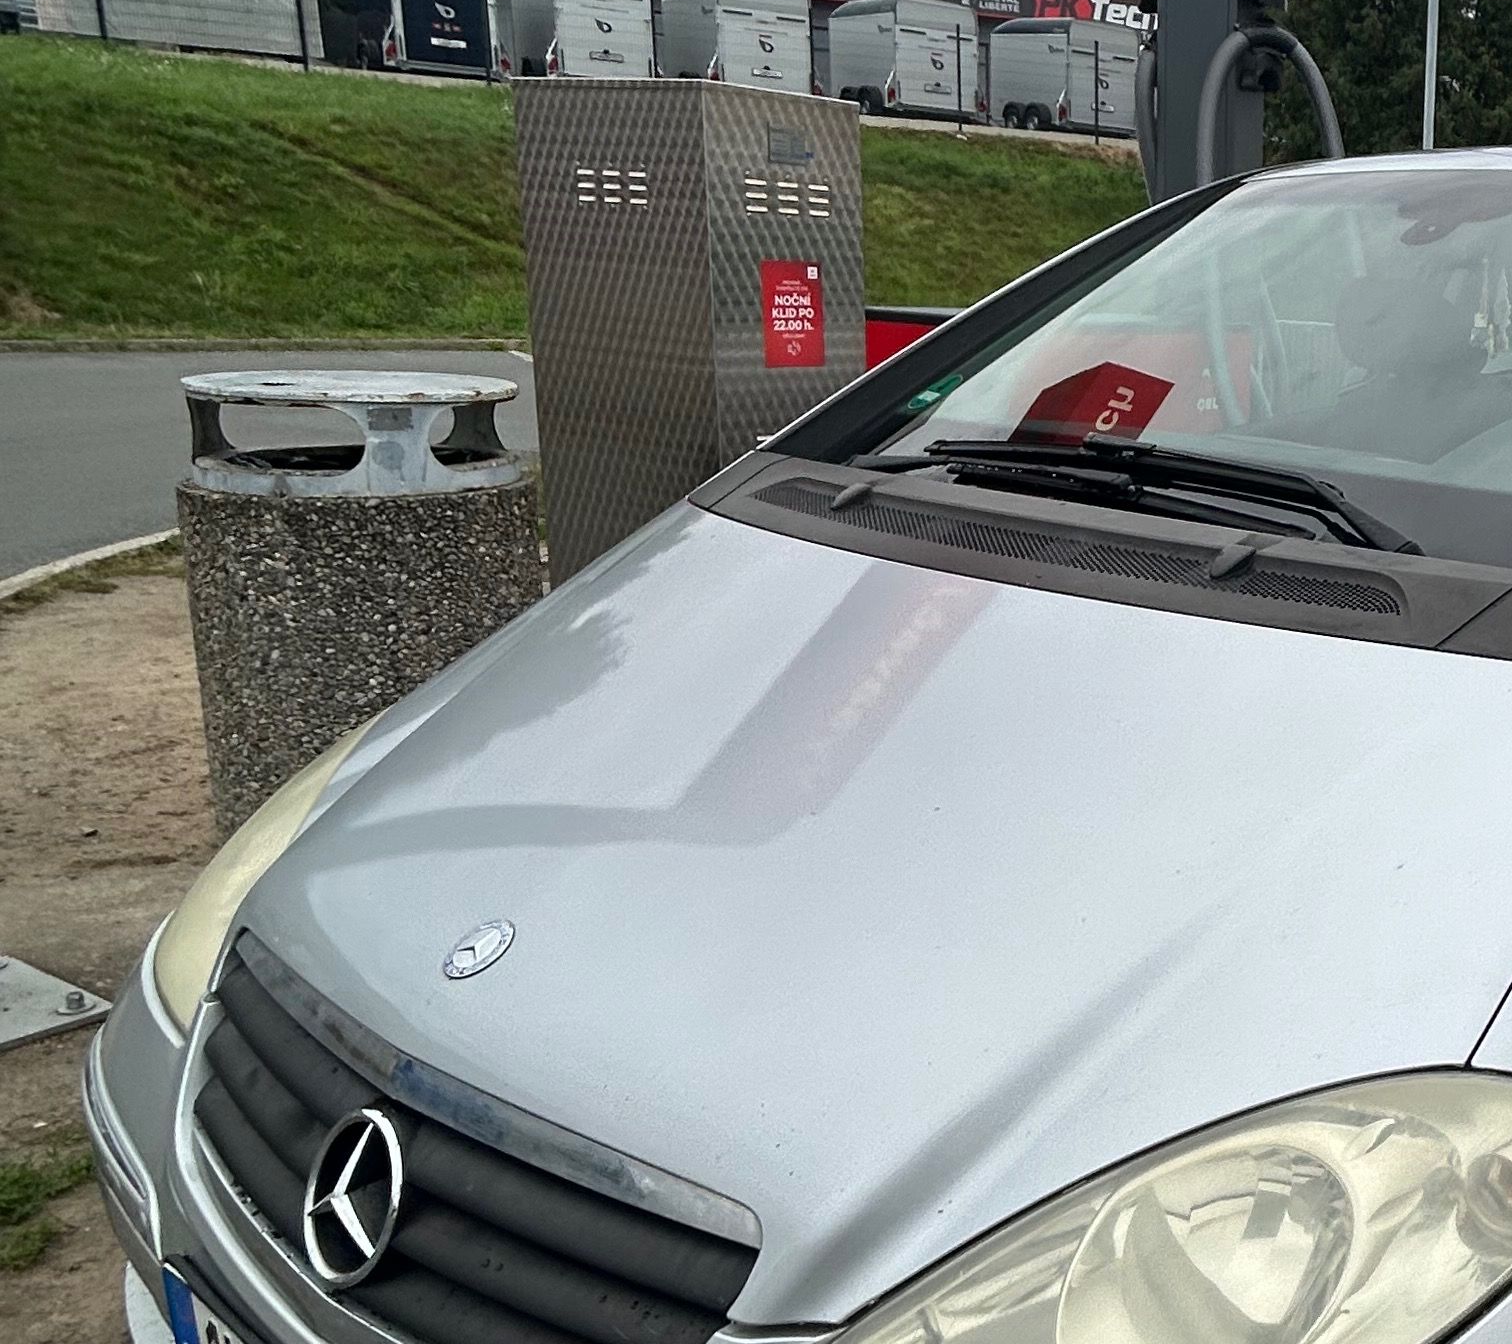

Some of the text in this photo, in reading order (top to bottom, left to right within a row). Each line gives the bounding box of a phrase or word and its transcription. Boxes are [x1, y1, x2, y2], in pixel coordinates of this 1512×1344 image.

[774, 293, 811, 306] NOČNÍ
[772, 307, 814, 319] KLID PO
[773, 319, 803, 331] 22.00
